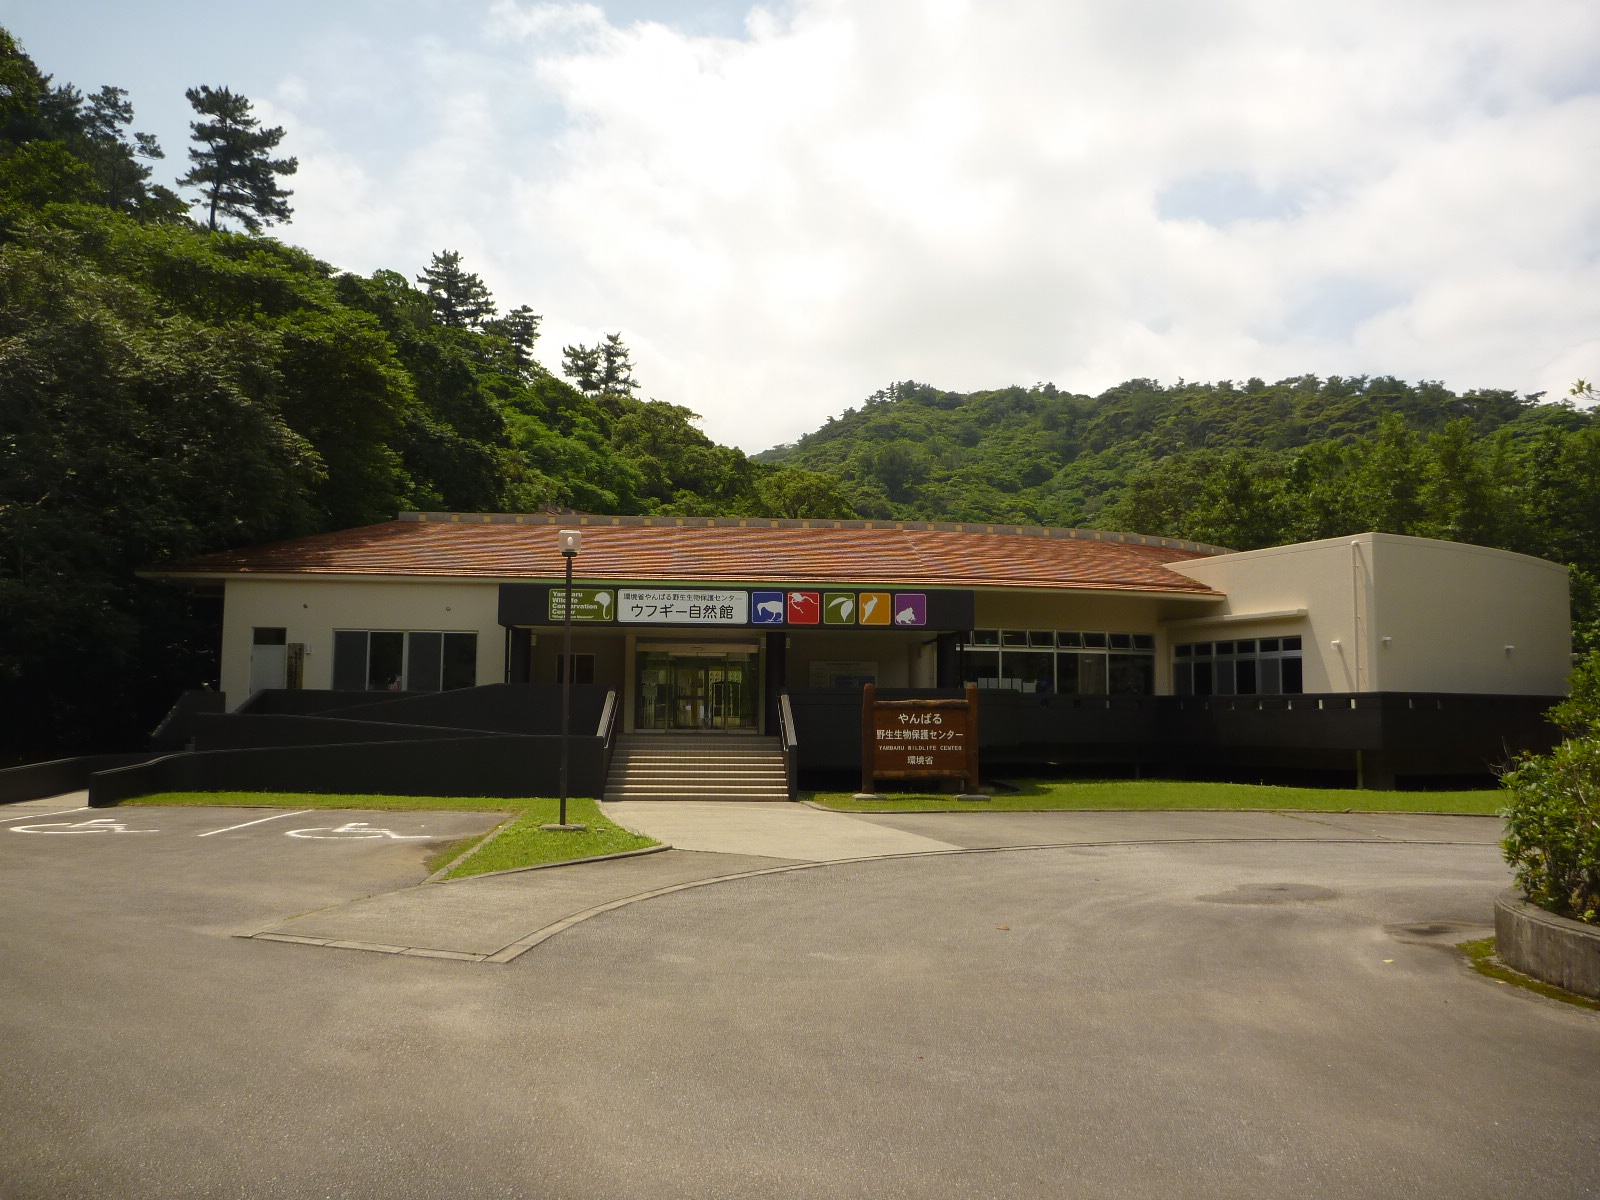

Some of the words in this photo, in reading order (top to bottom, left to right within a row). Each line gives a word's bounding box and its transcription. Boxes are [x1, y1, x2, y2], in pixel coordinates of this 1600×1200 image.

[623, 592, 743, 602] 環境省やんばる野生生物保護センター
[631, 603, 734, 619] ウフギー自然館
[898, 713, 942, 724] やんばる
[876, 729, 964, 740] 野生生物保護センター
[907, 755, 934, 765] 環境省
